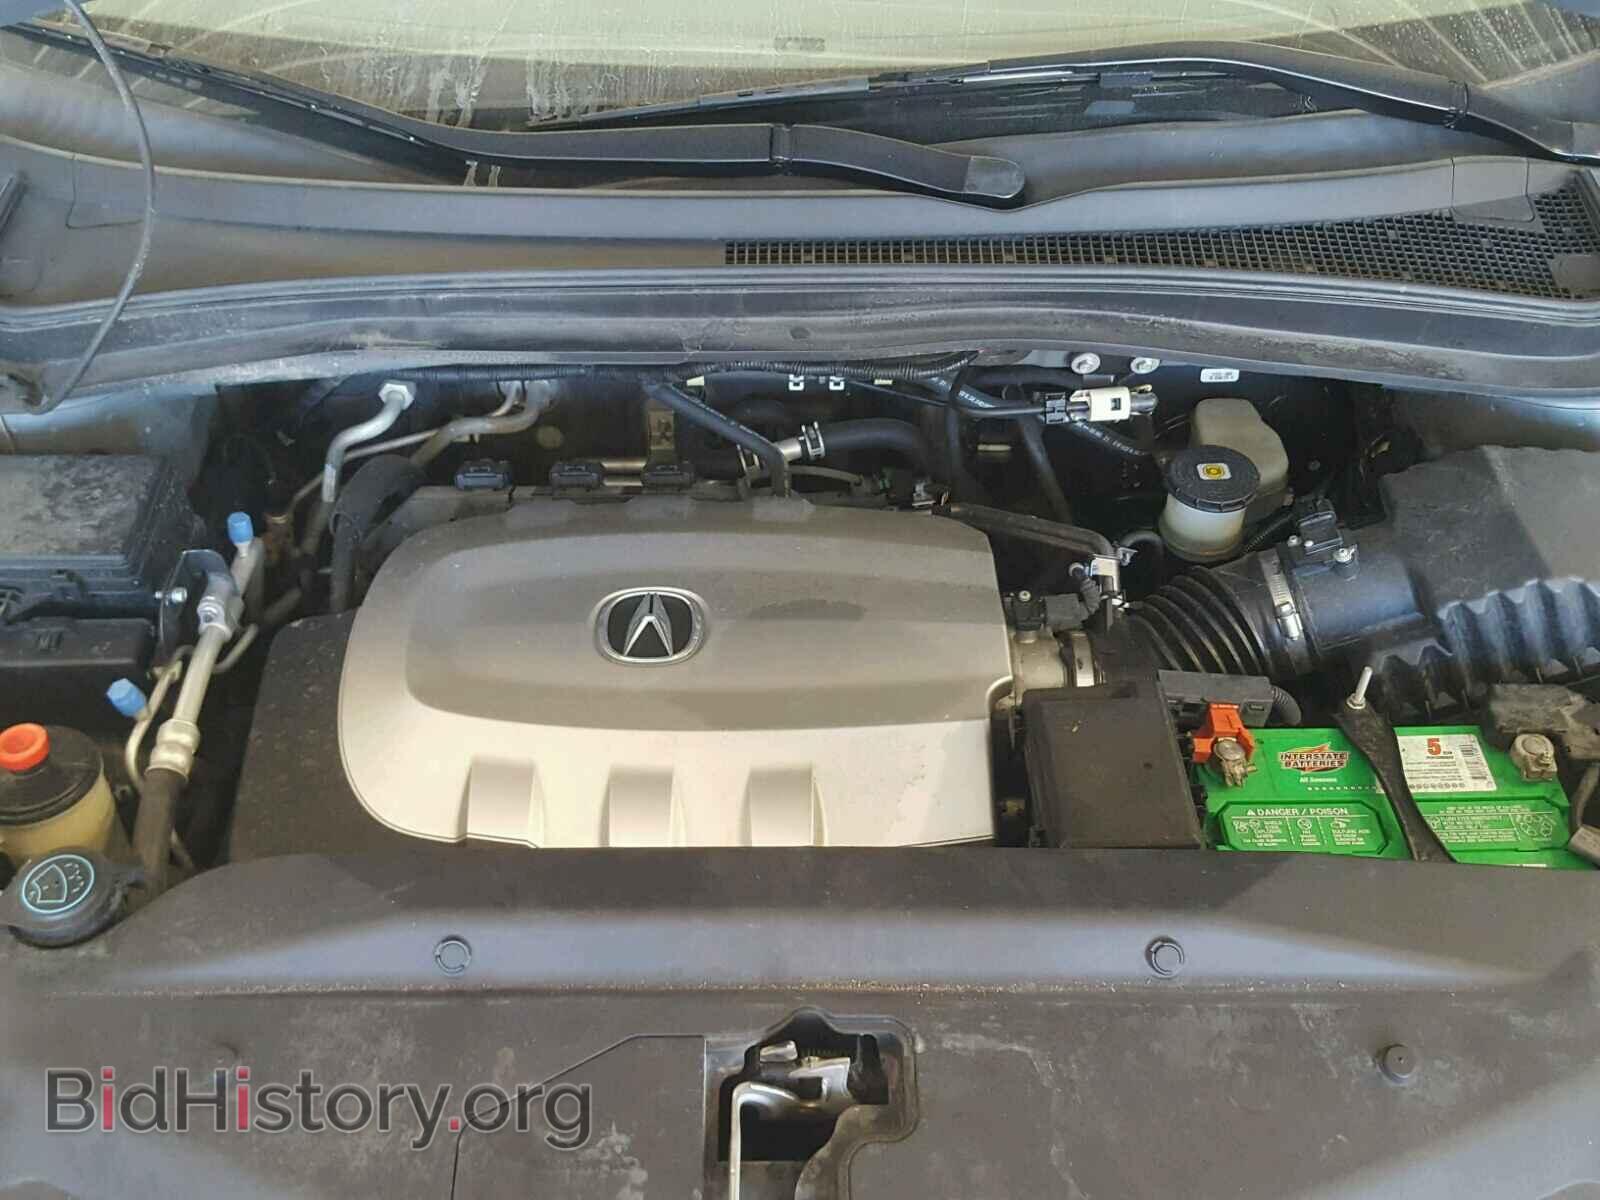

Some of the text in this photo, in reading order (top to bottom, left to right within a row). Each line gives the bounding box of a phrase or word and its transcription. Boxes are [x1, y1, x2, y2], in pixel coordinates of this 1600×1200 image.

[1427, 737, 1441, 755] 5
[1280, 752, 1347, 760] INTERSTATE
[1285, 760, 1345, 768] BATTERIES
[1257, 808, 1298, 816] DANGER
[1309, 807, 1348, 816] POISON
